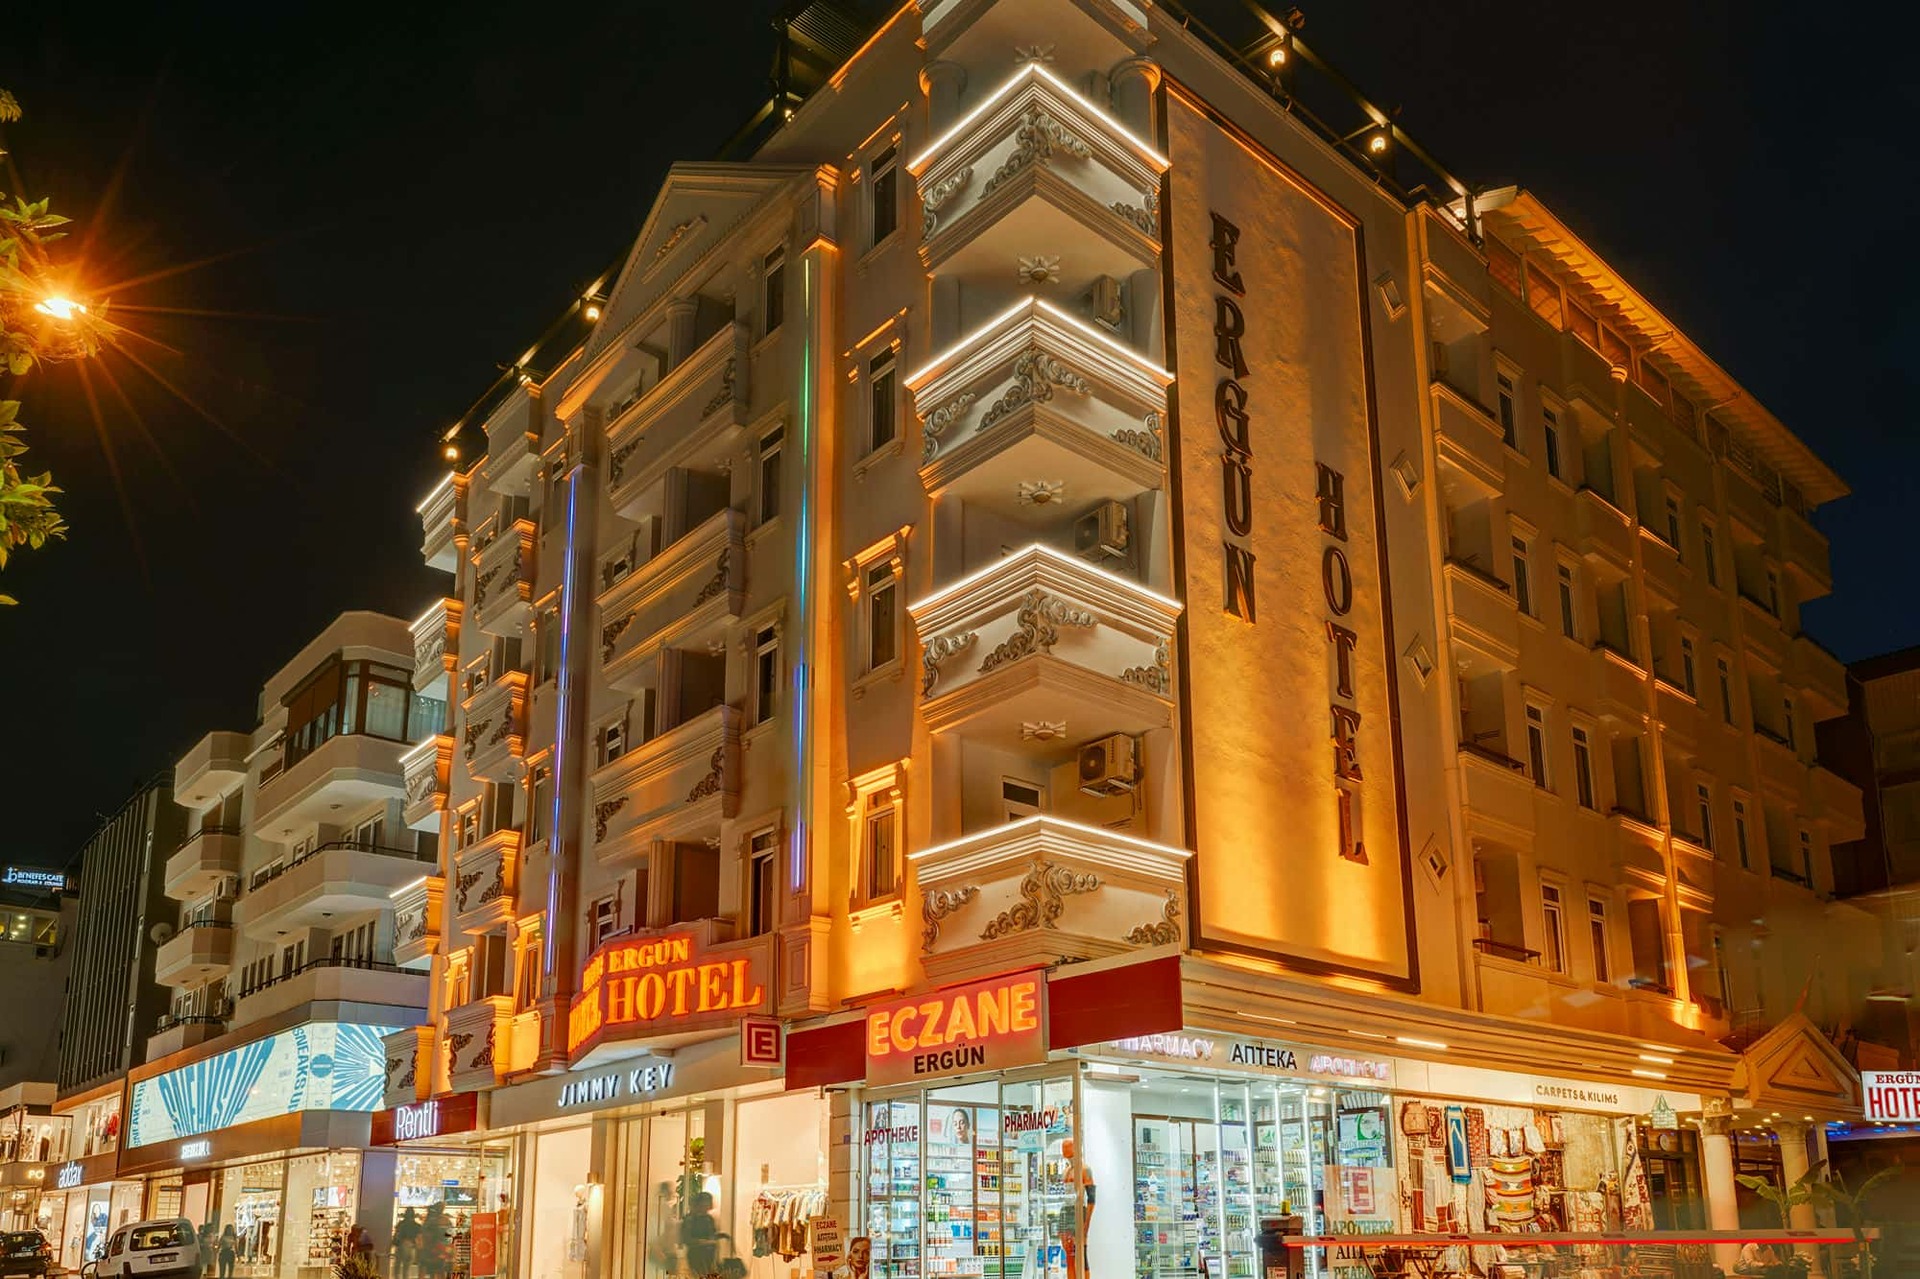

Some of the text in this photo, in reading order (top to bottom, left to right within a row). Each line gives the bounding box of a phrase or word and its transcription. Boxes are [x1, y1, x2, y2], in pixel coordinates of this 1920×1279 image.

[1316, 460, 1370, 867] HOTEL
[605, 959, 761, 1025] HOTEL
[868, 982, 1038, 1056] ECZANE
[914, 1043, 985, 1075] ERGÜN
[1109, 1034, 1214, 1060] HARMACY
[558, 1064, 673, 1108] JIMMY KEY
[864, 1126, 918, 1146] APOTHEKE
[1004, 1109, 1056, 1132] PHARMACY
